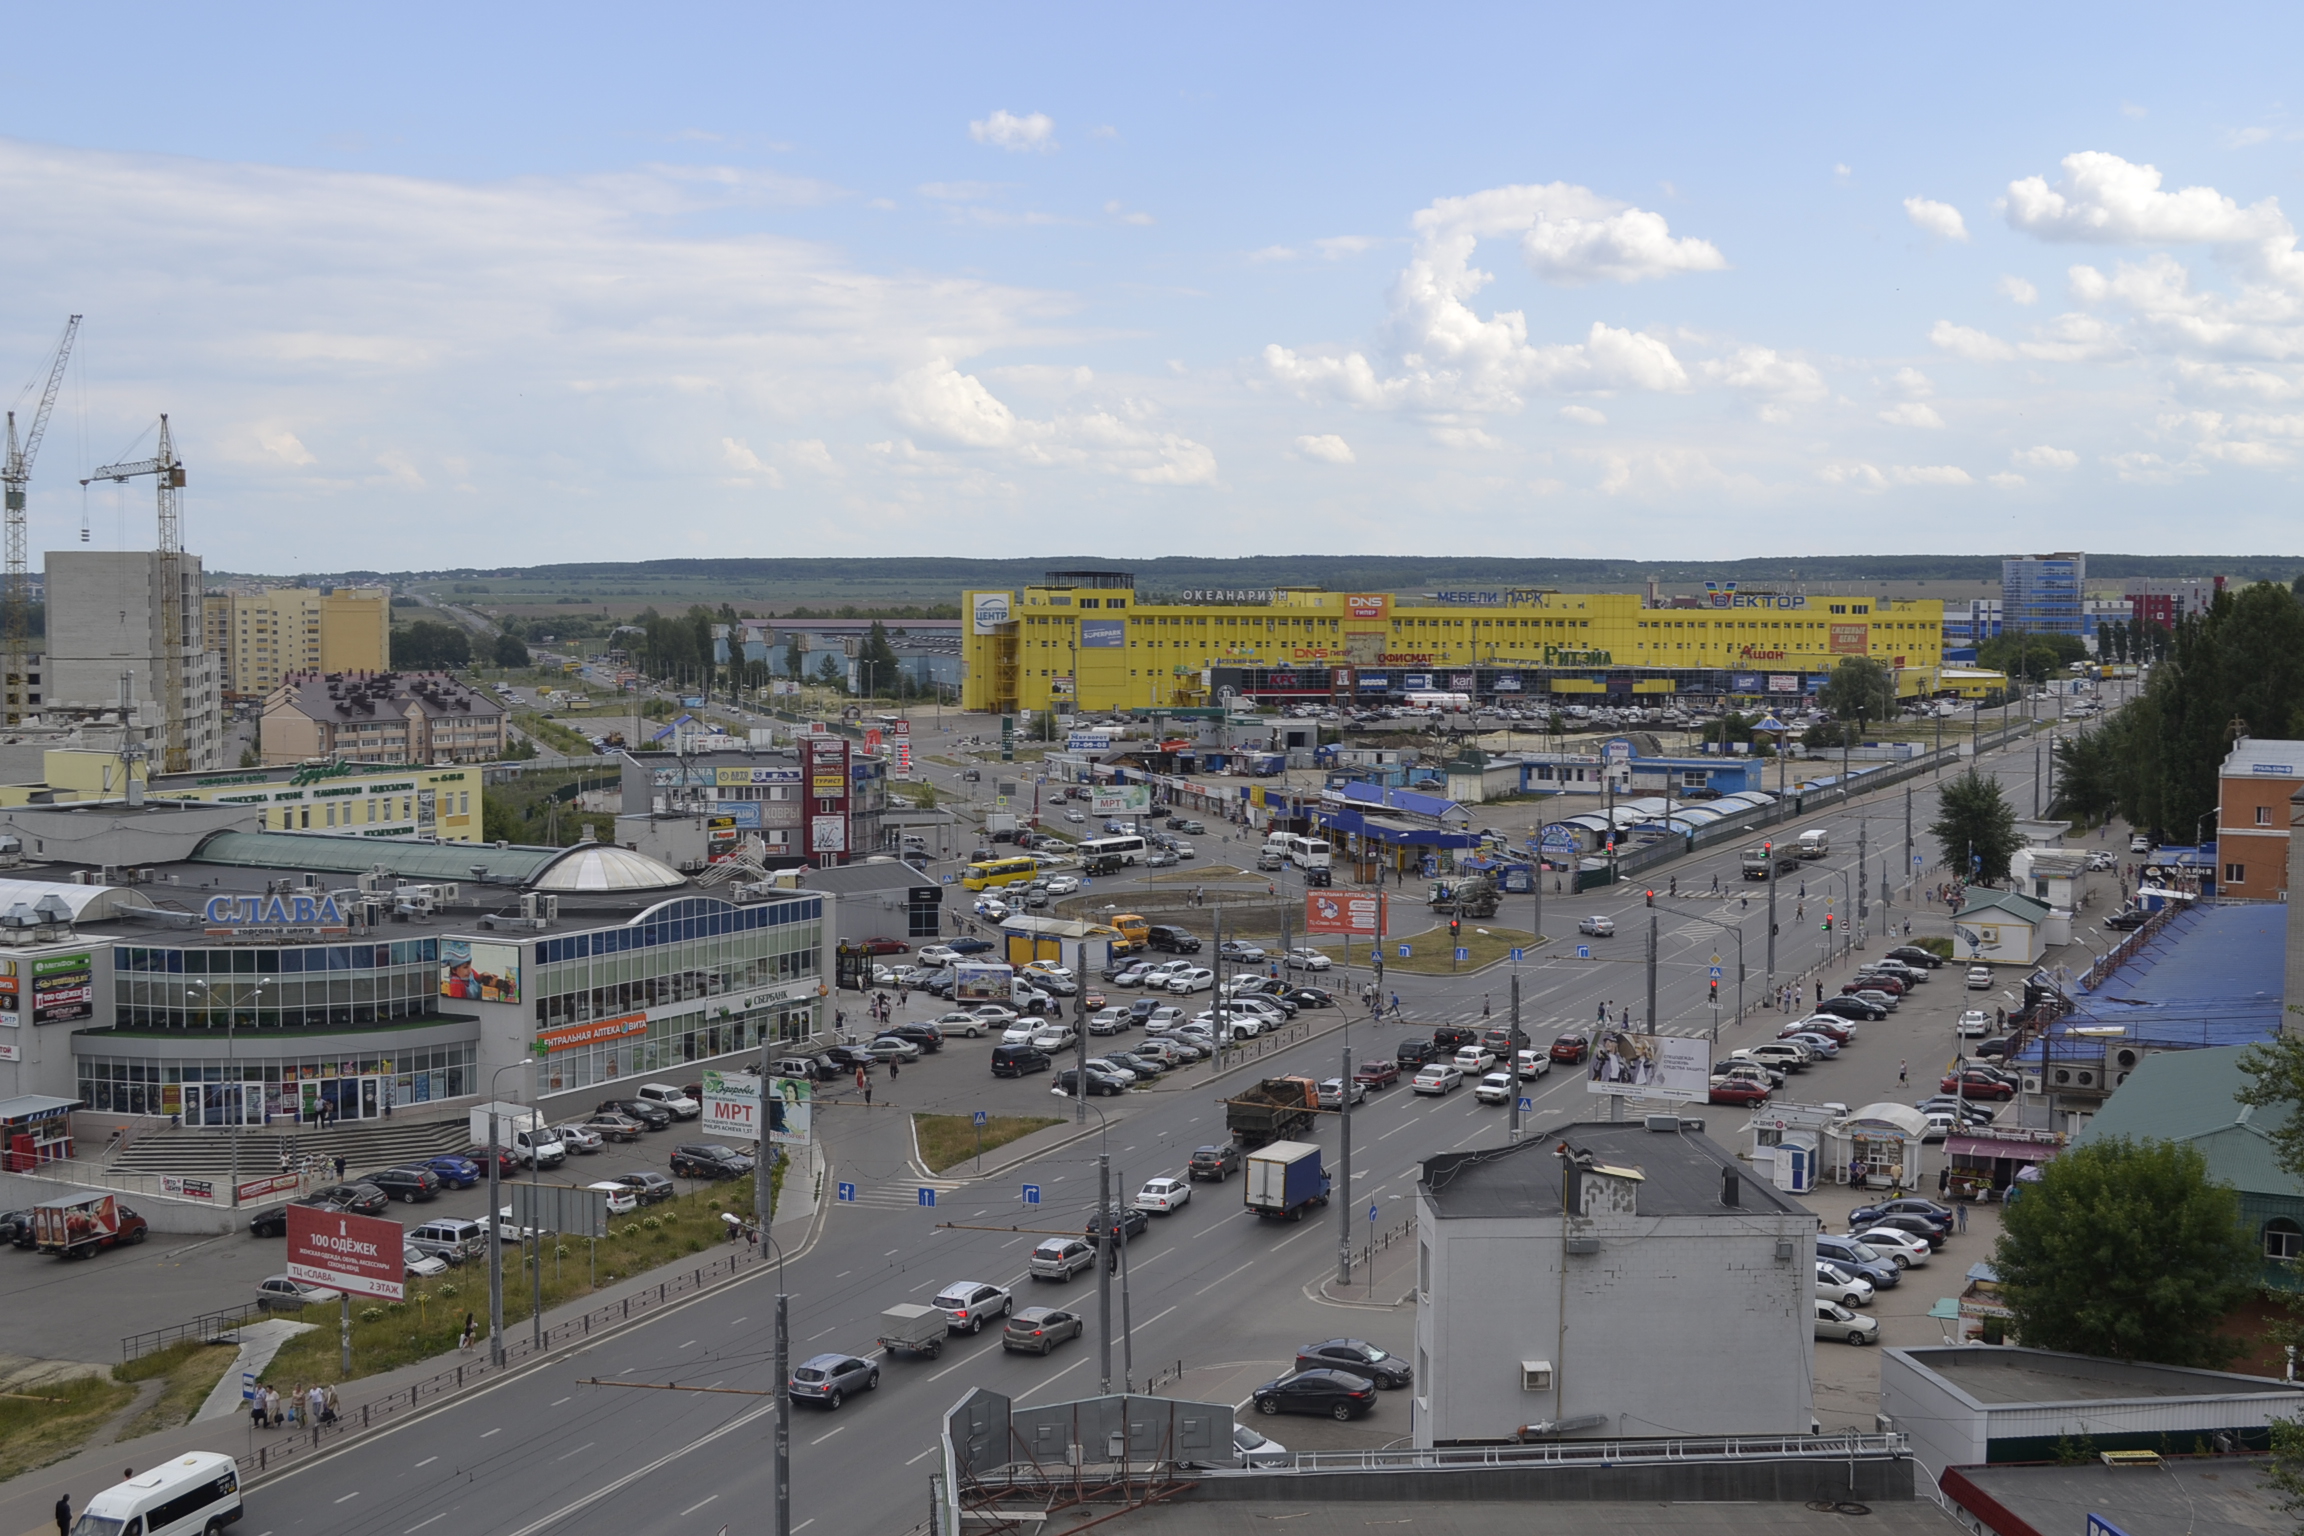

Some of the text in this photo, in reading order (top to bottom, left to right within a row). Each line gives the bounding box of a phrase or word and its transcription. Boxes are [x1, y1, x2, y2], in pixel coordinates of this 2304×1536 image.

[1183, 590, 1288, 601] ОКЕАНАРИУМ
[1437, 591, 1543, 603] МЕБЕЛИ ПАРК
[1714, 595, 1805, 608] ВЕКТОР
[1349, 597, 1383, 607] DNS
[975, 612, 1008, 622] ЦЕНТР
[1831, 626, 1866, 634] СМЕШНЫЕ
[1838, 634, 1859, 643] ЦЕНЫ
[1294, 648, 1328, 658] DNS
[1378, 653, 1435, 663] ОФИСМАГ
[1269, 674, 1297, 684] KFC
[1452, 674, 1473, 686] kari
[275, 790, 304, 801] ЛЕЧЕНИЕ
[1100, 799, 1121, 808] МРТ
[764, 807, 800, 819] КОВРЫ
[206, 894, 343, 924] СЛАВА
[287, 927, 315, 935] центр
[85, 988, 90, 996] 2
[754, 990, 788, 1005] СБЕРБАНК
[544, 1019, 647, 1047] ЕНТРАЛЬНАЯ АПТЕКА ВИТА
[716, 1081, 755, 1096] Здоровье
[714, 1102, 753, 1122] МРТ
[311, 1233, 378, 1257] 100 ОДЁЖЕК
[299, 1248, 321, 1257] ЖЕНСКАЯ
[359, 1259, 390, 1270] АКСЕССУАРЫ
[292, 1266, 336, 1283] ТЦ «СЛАВА»
[369, 1281, 399, 1295] 2 ЭТАЖ
